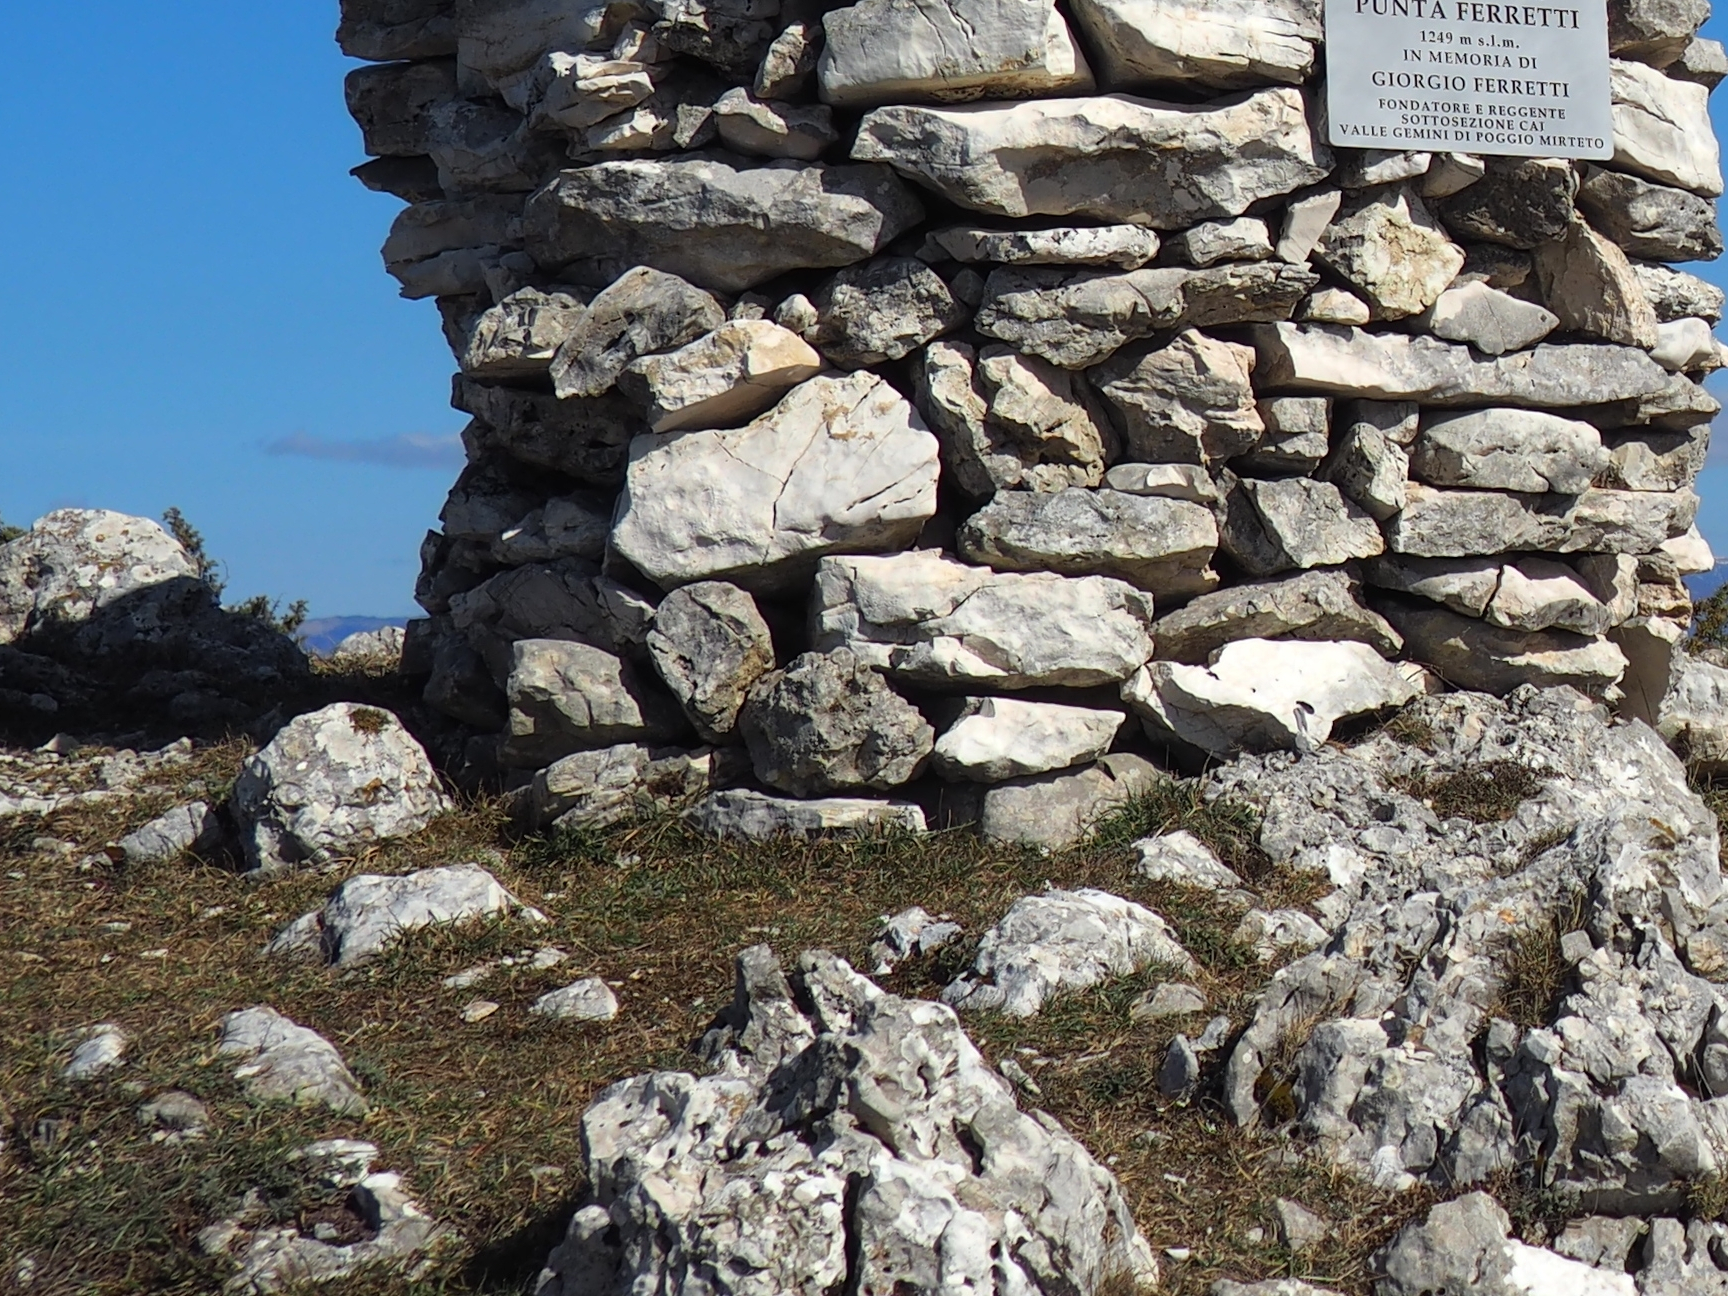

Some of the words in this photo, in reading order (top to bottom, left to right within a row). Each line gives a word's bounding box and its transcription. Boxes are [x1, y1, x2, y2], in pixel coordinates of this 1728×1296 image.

[1457, 1, 1580, 29] FERRETTI
[1420, 30, 1454, 44] 1249
[1459, 34, 1472, 45] m
[1478, 34, 1520, 49] s.l.m.
[1403, 48, 1422, 61] IN
[1429, 49, 1512, 67] MEMORIA
[1518, 56, 1537, 69] DI
[1372, 70, 1466, 91] GIORGIO
[1474, 77, 1570, 97] FERRETTI
[1379, 98, 1471, 114] FONDATORE
[1475, 103, 1484, 114] E
[1489, 104, 1566, 119] REGGENTE
[1401, 113, 1515, 130] SOTTOSEZIONE
[1340, 123, 1388, 136] VALLE
[1393, 126, 1450, 140] GEMINI
[1454, 130, 1471, 141] DI
[1477, 131, 1534, 145] POGGIO
[1540, 136, 1605, 149] MIRTETO
